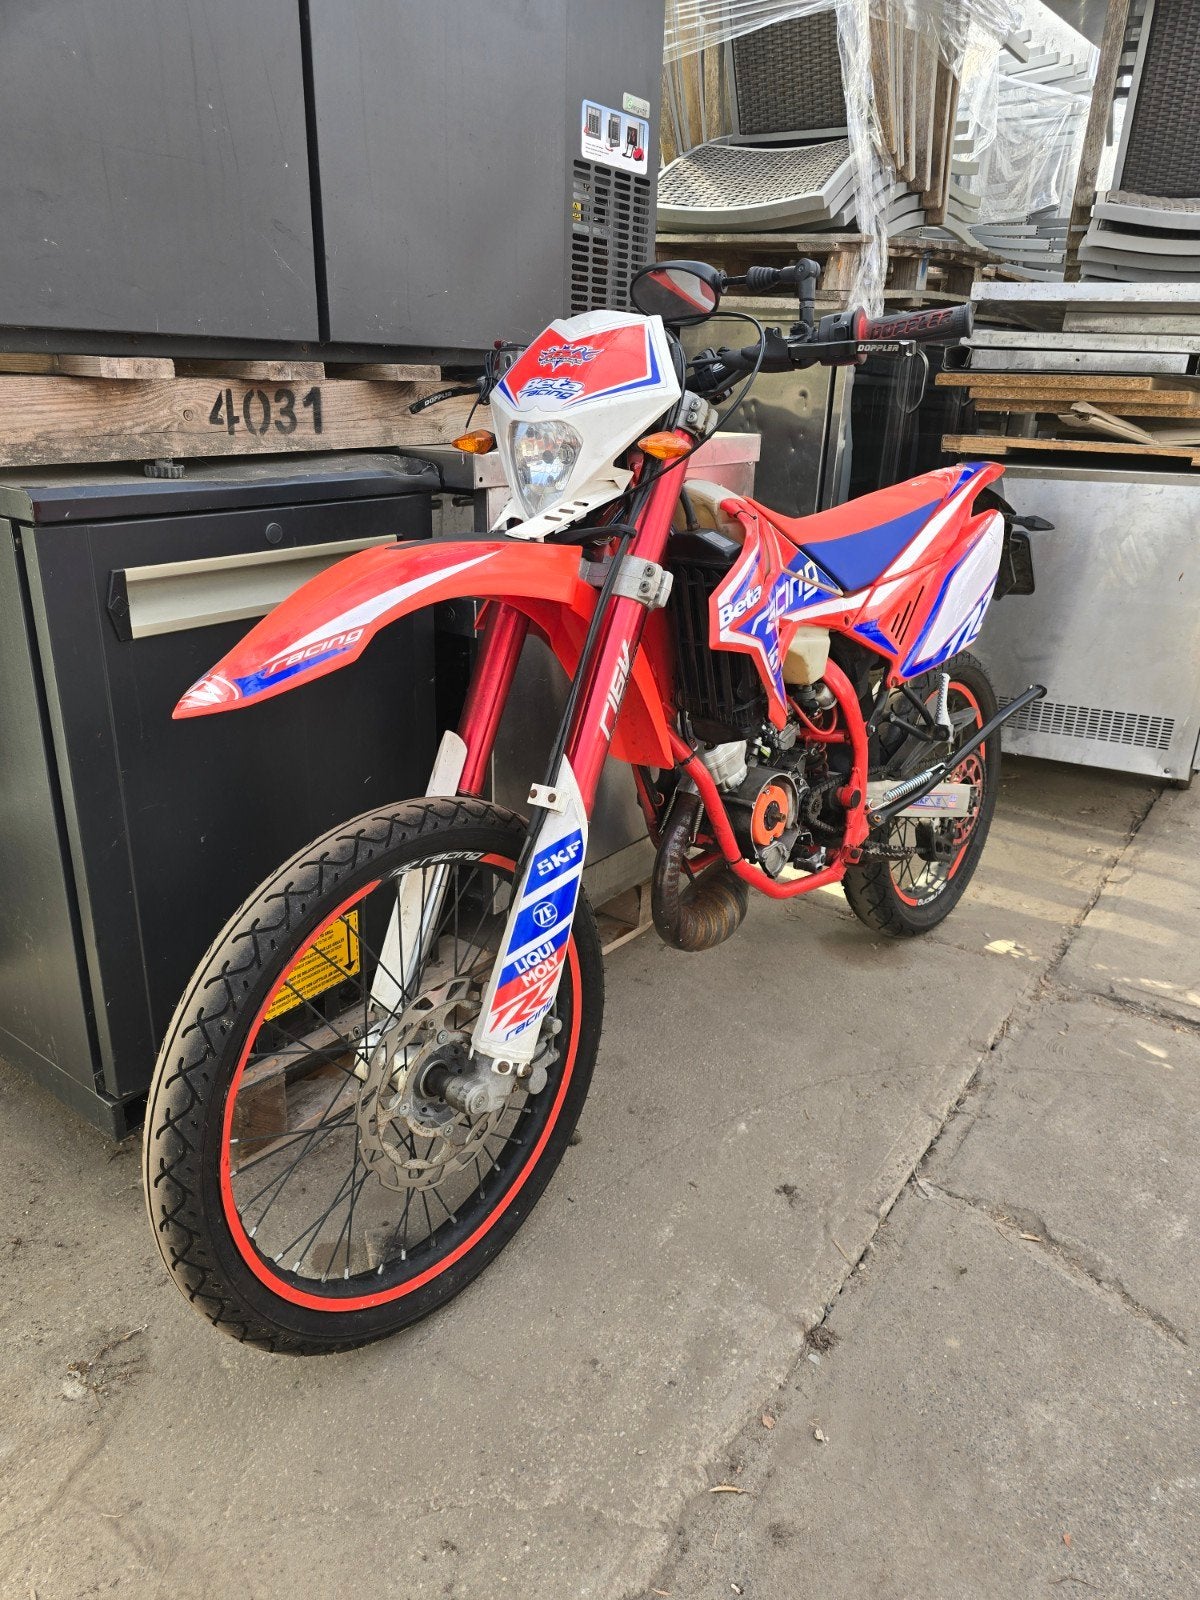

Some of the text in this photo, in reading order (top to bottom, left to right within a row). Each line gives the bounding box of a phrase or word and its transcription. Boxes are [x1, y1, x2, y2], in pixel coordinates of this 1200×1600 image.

[870, 310, 953, 339] DOPPLER
[857, 344, 899, 352] DOPPLER
[209, 386, 323, 436] 4031
[719, 585, 762, 624] Beta
[268, 628, 365, 674] racing
[420, 851, 485, 866] racing
[537, 839, 582, 876] SKF
[514, 940, 556, 973] LIQUI
[521, 953, 560, 988] MOLY
[505, 997, 554, 1042] racing
